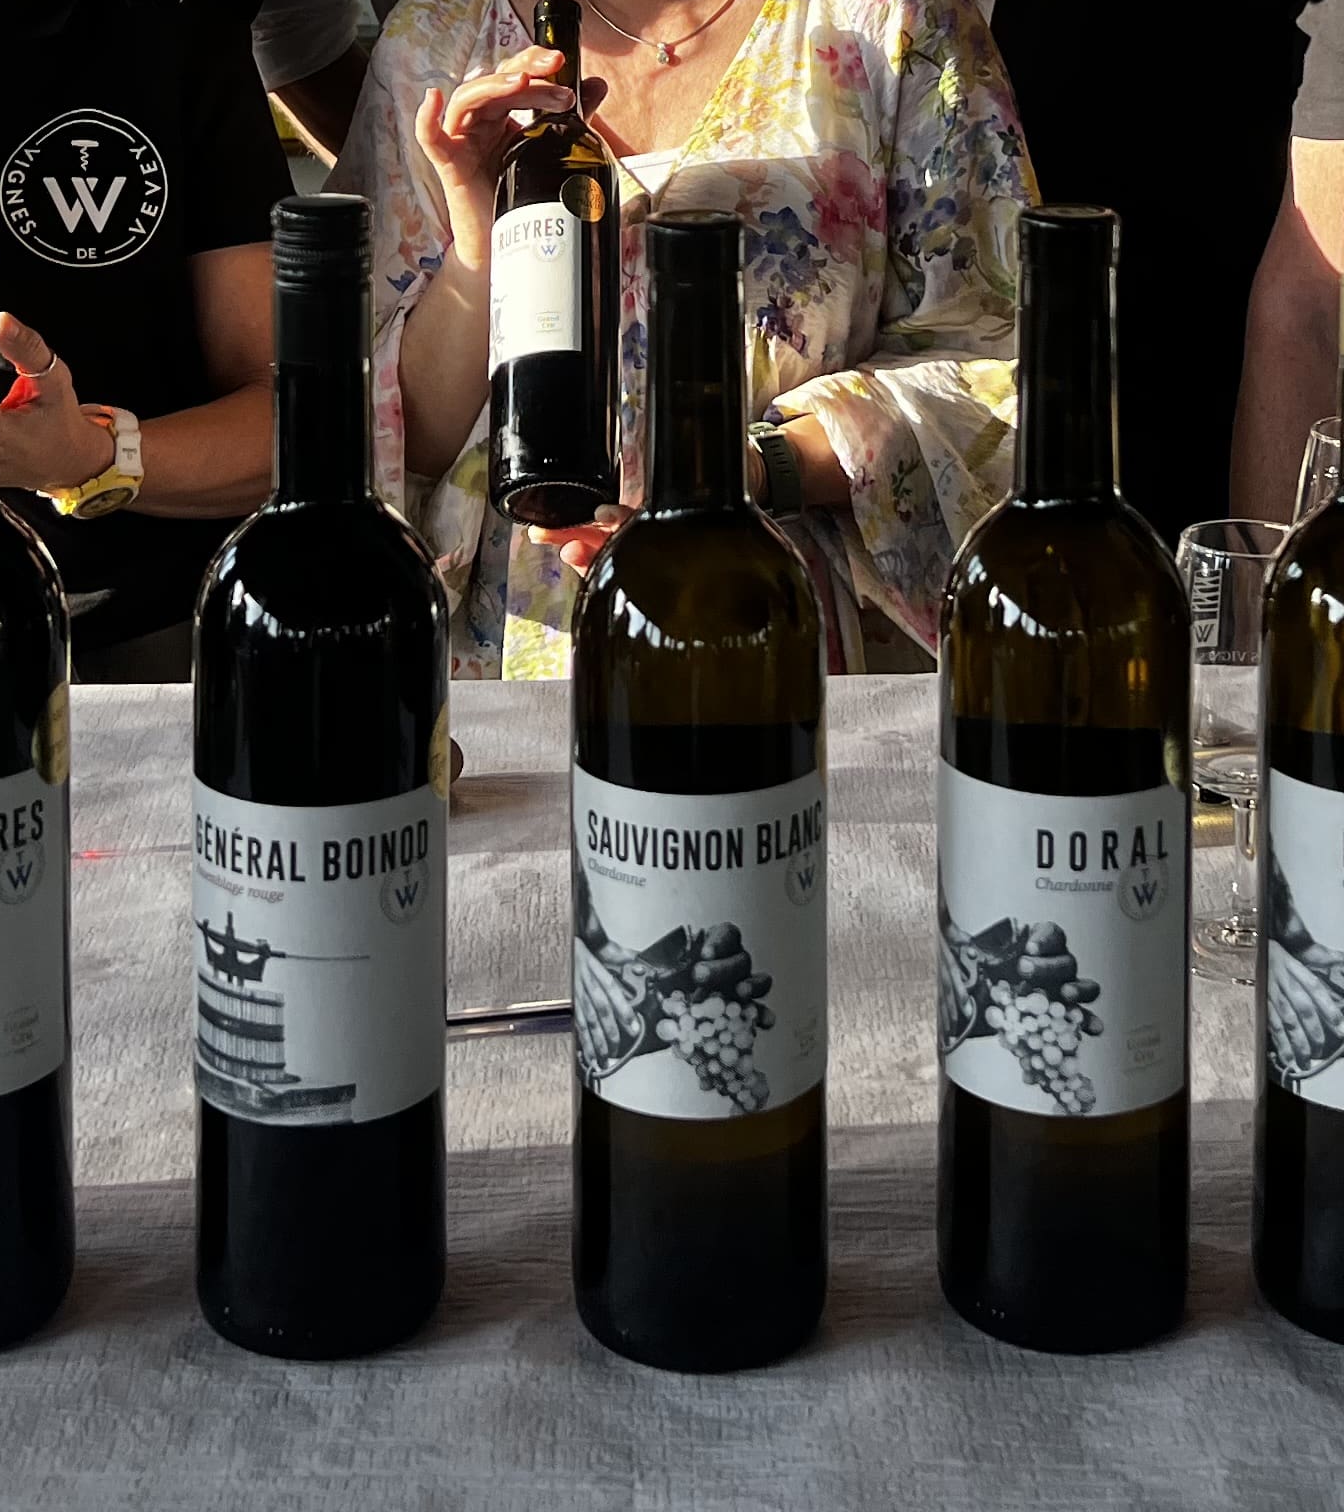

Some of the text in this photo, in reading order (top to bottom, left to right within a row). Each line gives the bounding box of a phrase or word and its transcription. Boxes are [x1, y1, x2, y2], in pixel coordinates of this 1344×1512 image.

[5, 144, 163, 260] VIGNES DE VEVEY
[498, 217, 565, 251] RUEYRES
[196, 813, 429, 882] GÉNÉRAL BOINOD
[587, 799, 823, 871] SAUVIGNON BLANC
[1036, 820, 1168, 871] DORAL
[587, 857, 647, 887] Chardonne
[1035, 877, 1114, 892] Chardonne
[247, 883, 284, 904] rouge
